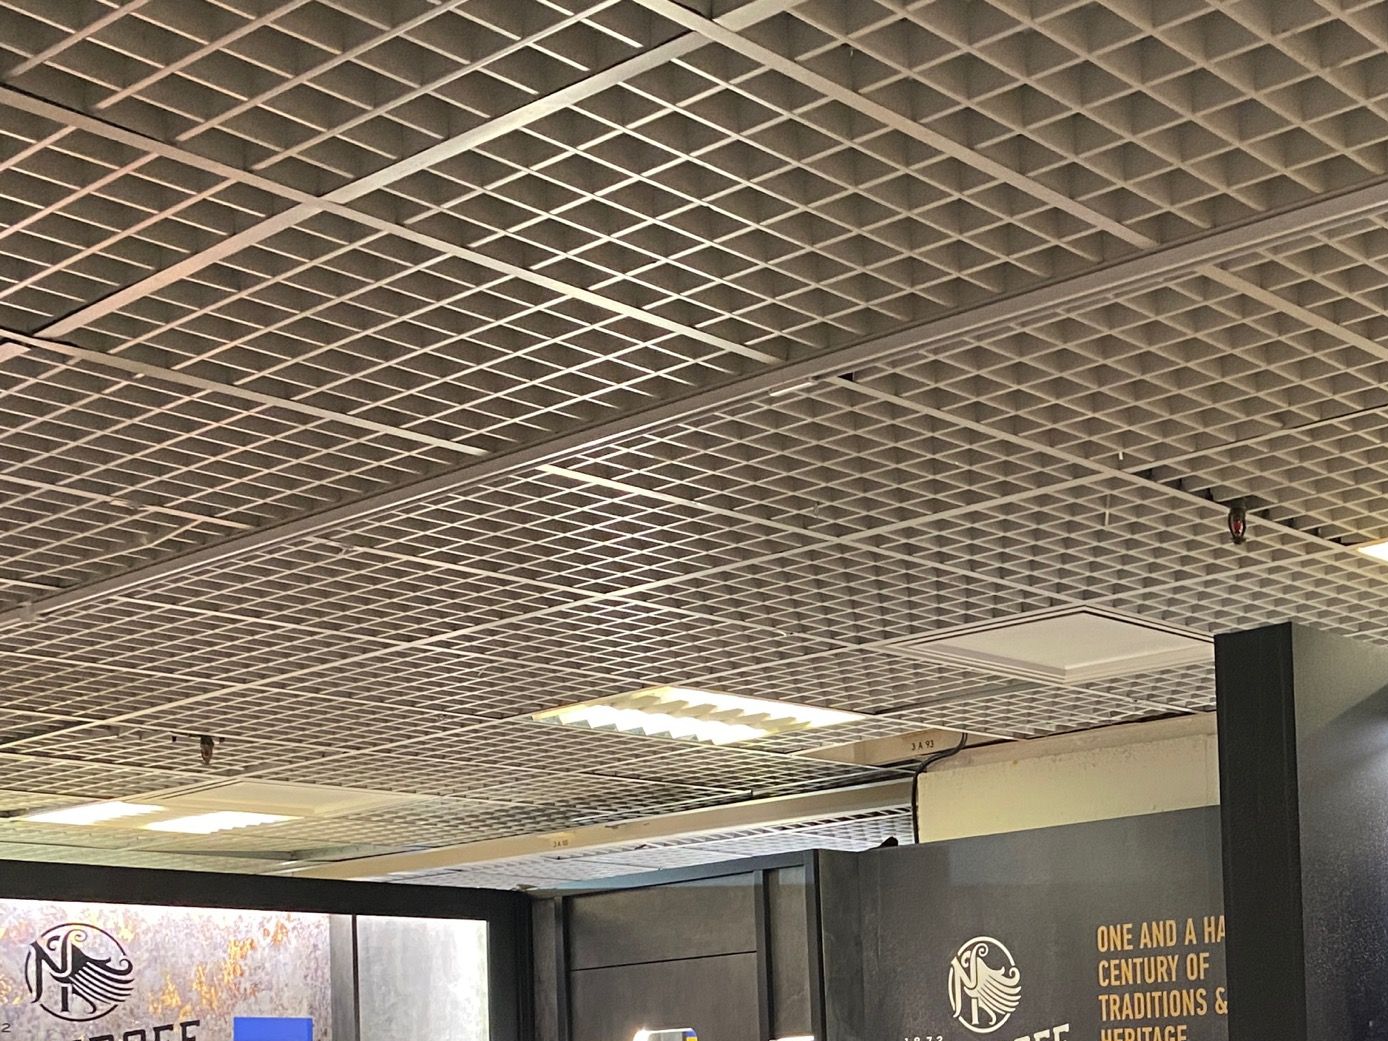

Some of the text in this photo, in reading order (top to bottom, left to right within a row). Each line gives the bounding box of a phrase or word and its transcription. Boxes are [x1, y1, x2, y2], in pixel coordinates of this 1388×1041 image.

[1097, 923, 1133, 952] ONE
[1140, 919, 1177, 949] AND
[1184, 918, 1197, 945] A
[1098, 952, 1210, 987] CENTURY OF
[1098, 987, 1228, 1022] TRADITIONS &
